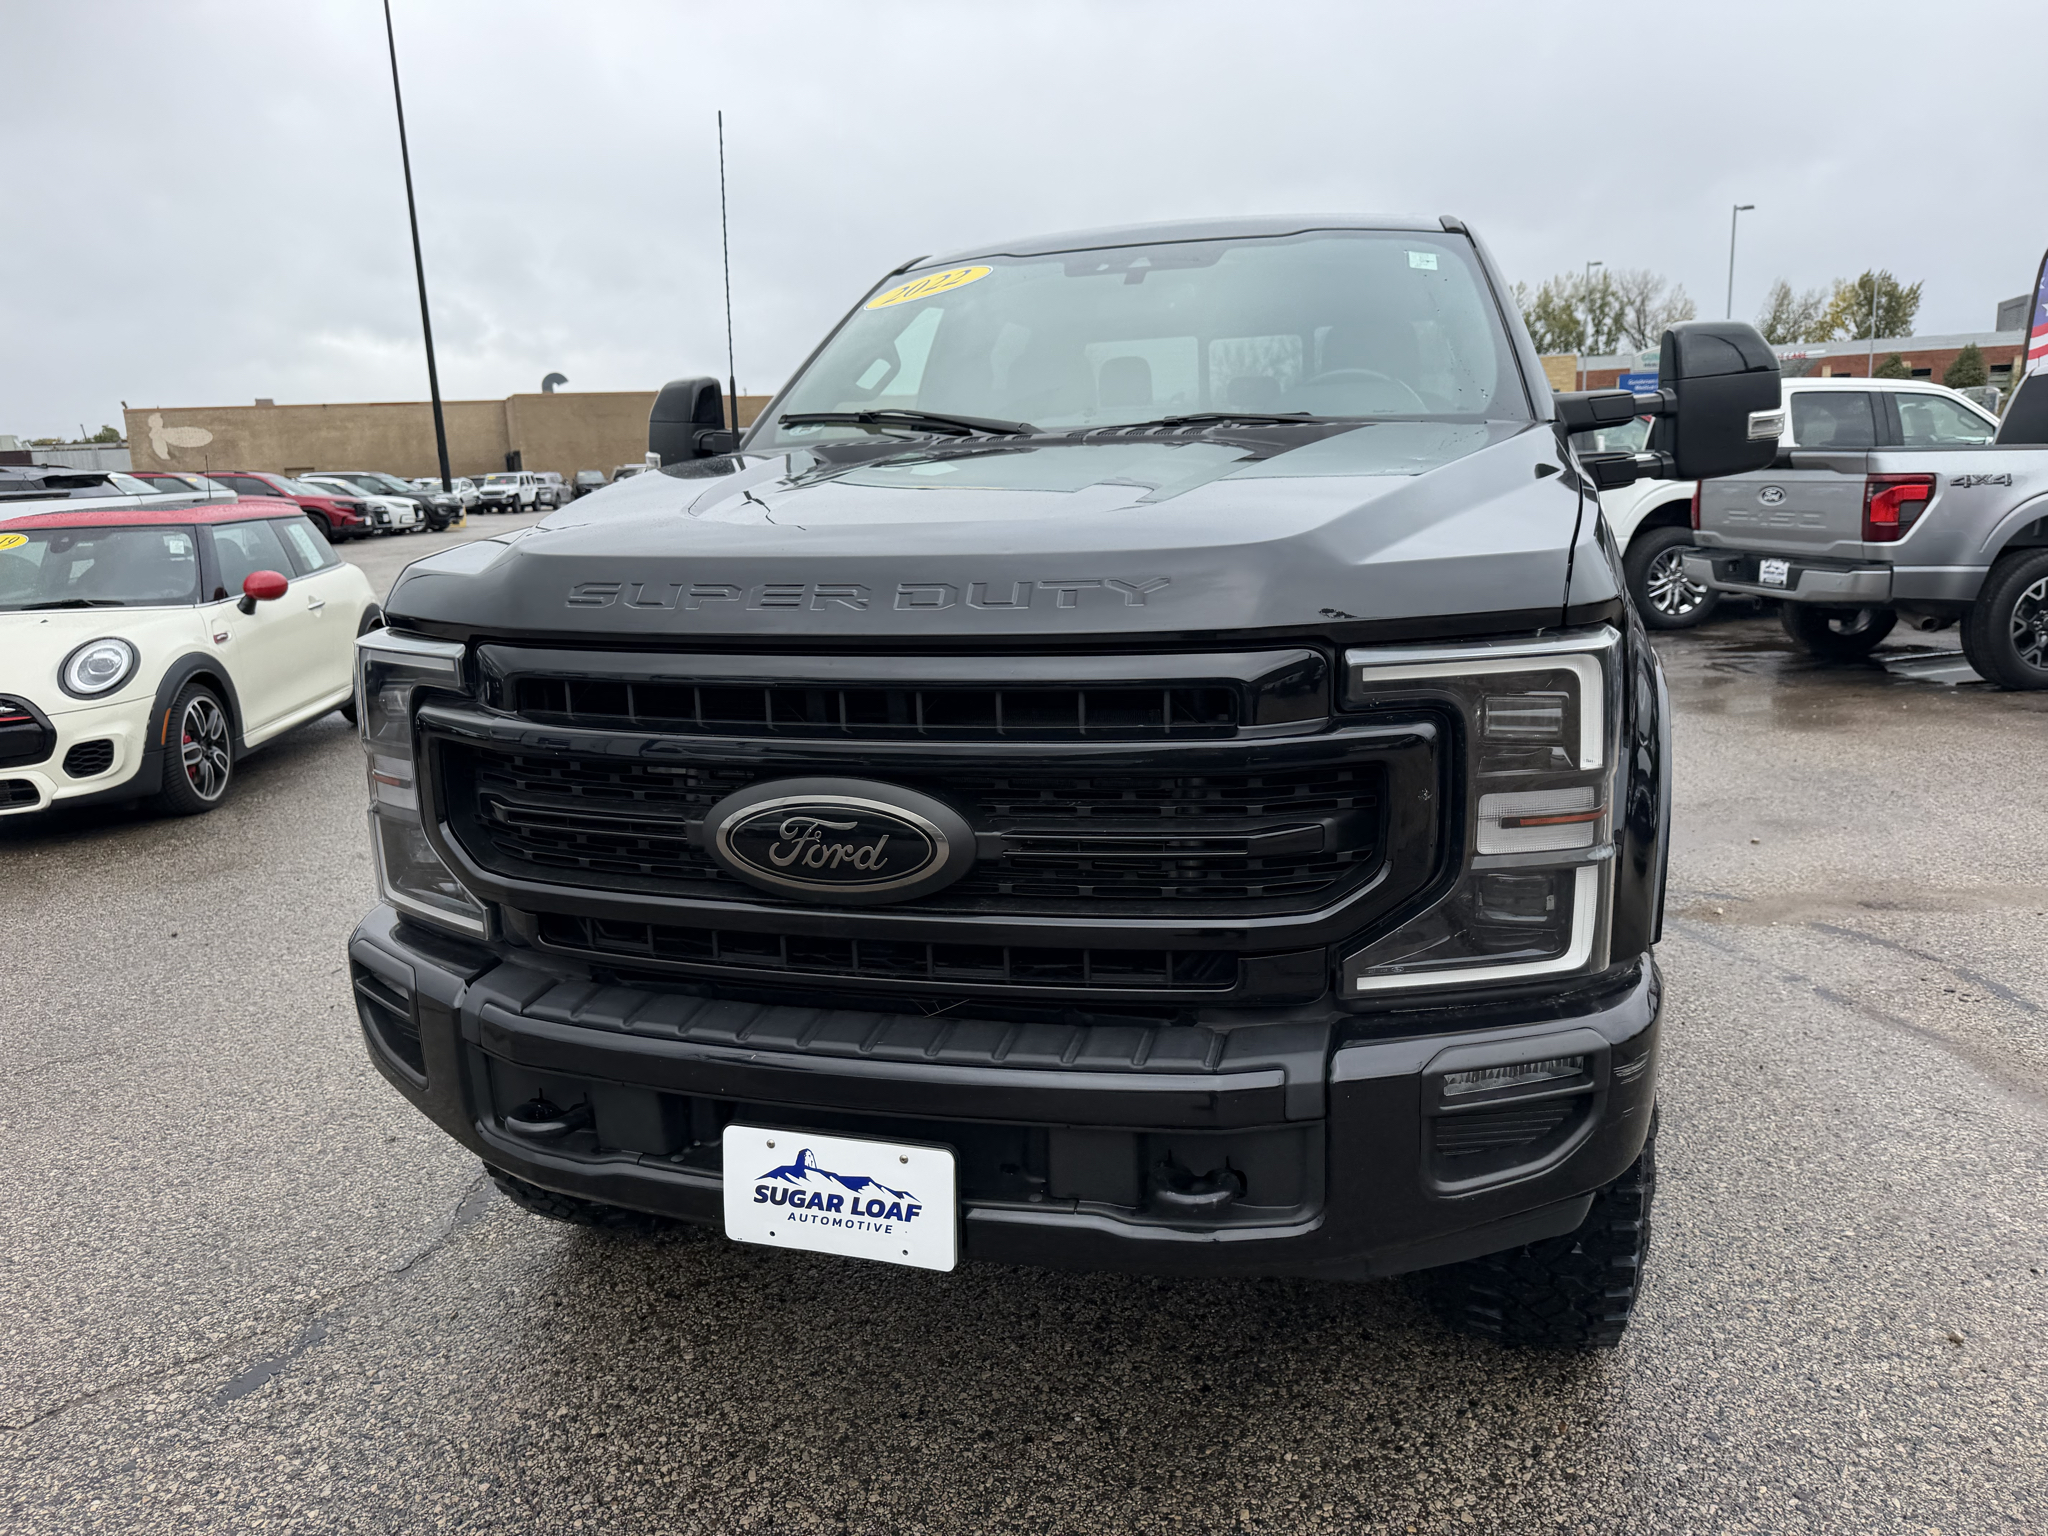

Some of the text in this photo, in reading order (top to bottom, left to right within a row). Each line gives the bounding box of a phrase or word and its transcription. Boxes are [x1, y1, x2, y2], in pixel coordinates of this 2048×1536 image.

[882, 269, 972, 304] 2022
[564, 577, 1172, 612] SUPER DUTY
[768, 816, 890, 871] Ford
[753, 1184, 923, 1223] SUGAR LOAF
[787, 1212, 894, 1235] AUTOMOTIVE
